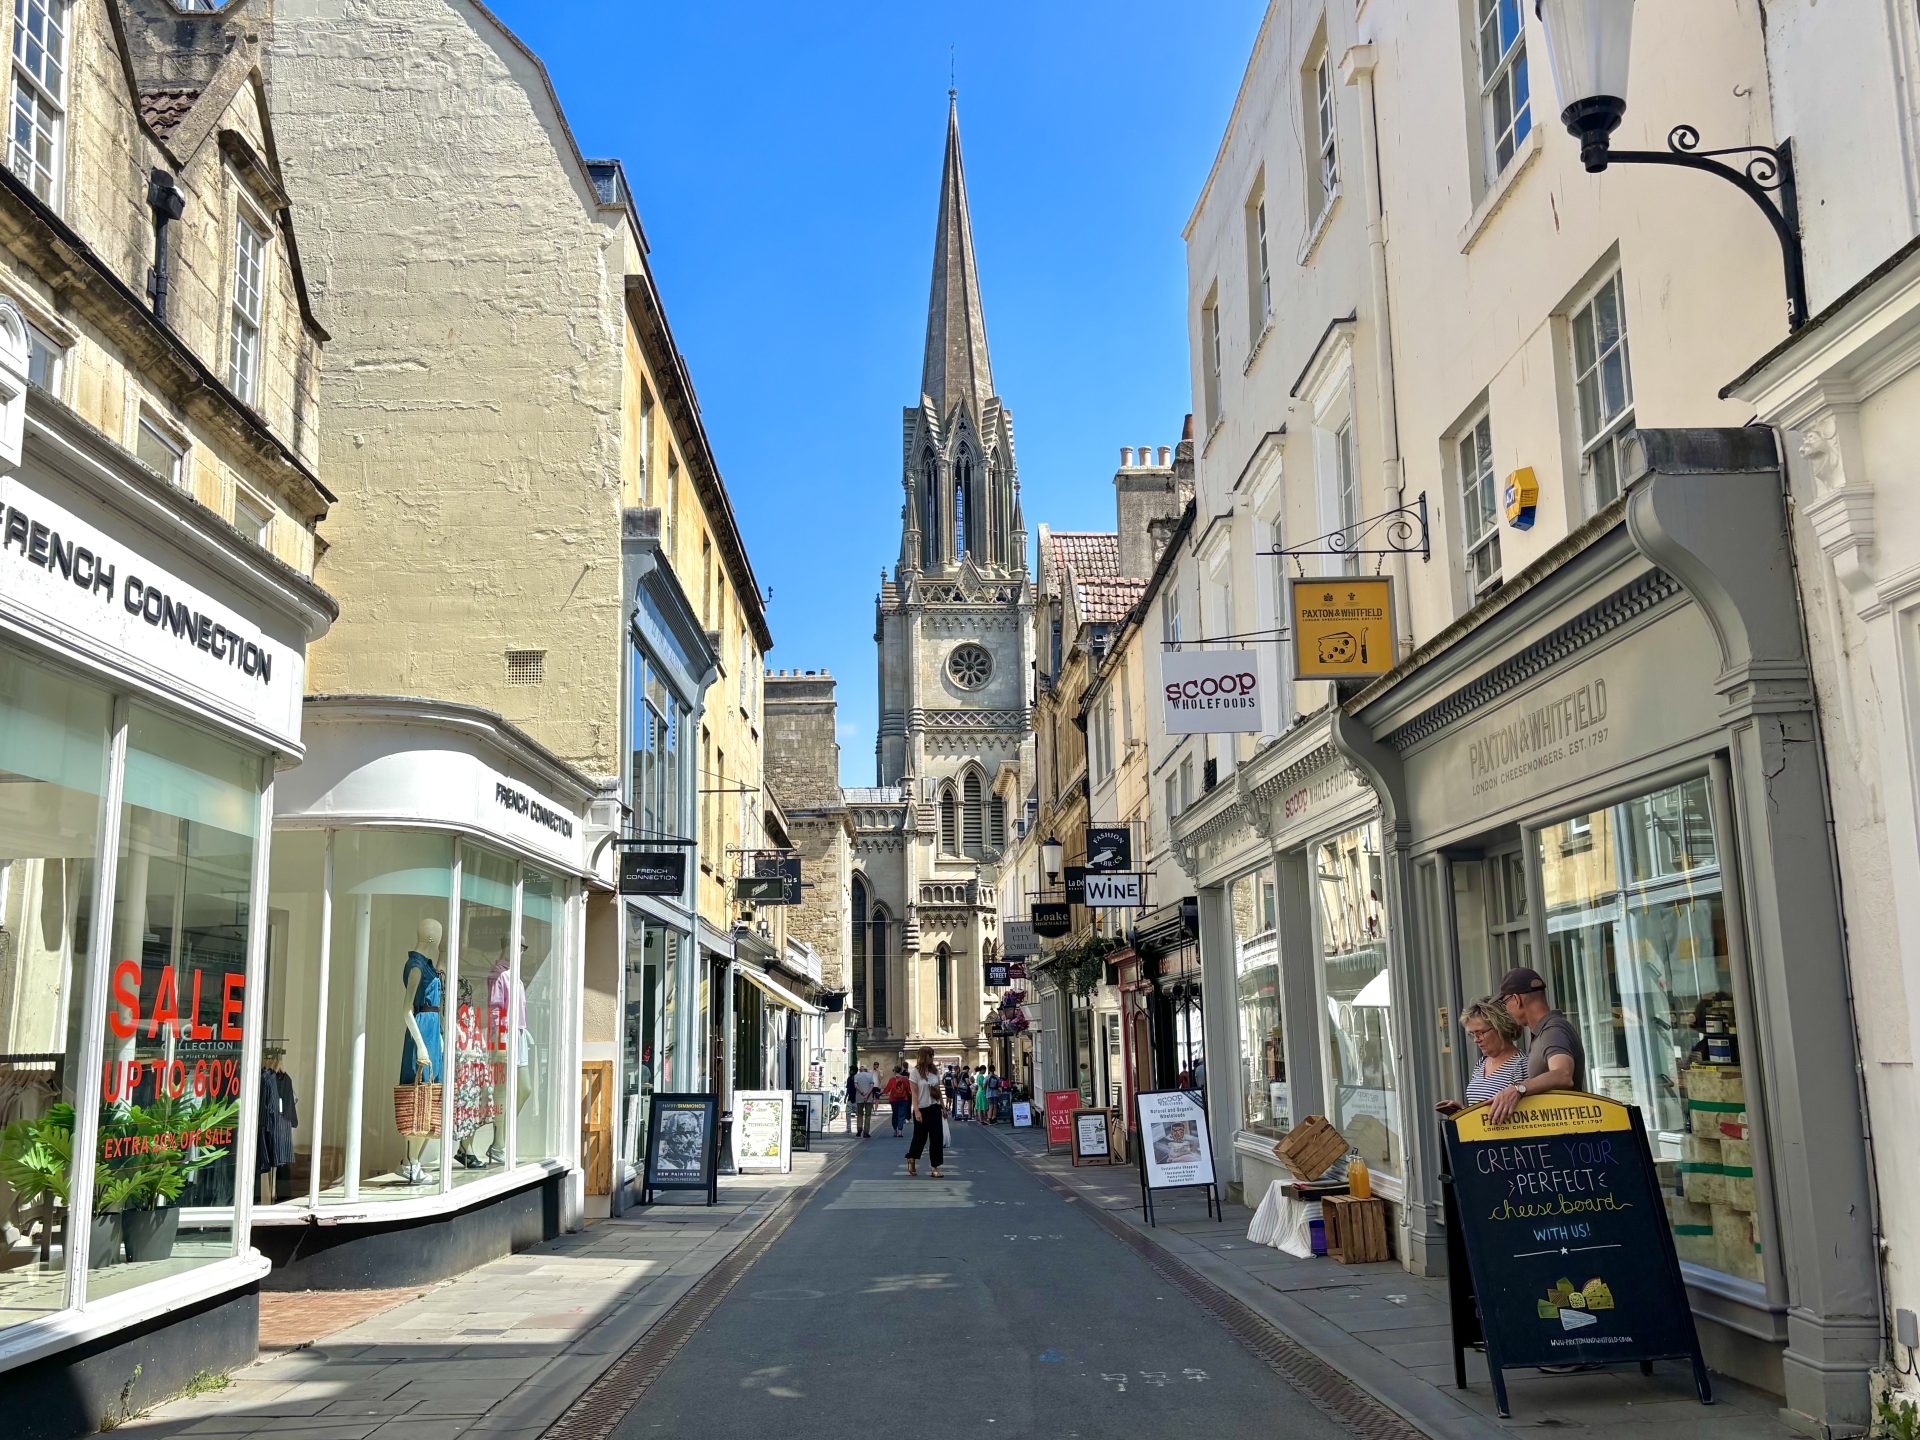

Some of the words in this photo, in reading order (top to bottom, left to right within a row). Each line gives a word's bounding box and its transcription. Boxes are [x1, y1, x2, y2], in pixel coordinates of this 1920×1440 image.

[0, 502, 115, 603] RENCH
[124, 575, 272, 685] CONNECTION
[1172, 698, 1256, 710] WHOLEFOODS
[1472, 778, 1498, 796] LONDON
[1500, 748, 1566, 784] CHEESEMONGERS.
[496, 782, 529, 816] FRENCH
[530, 800, 573, 839] CONNECTION
[1093, 832, 1124, 844] FASHION
[1035, 912, 1068, 922] Loake
[110, 960, 245, 1041] SALE
[458, 1003, 508, 1051] SALE
[104, 1060, 142, 1103] UP
[152, 1059, 186, 1100] TO
[194, 1059, 240, 1098] 60%
[104, 1136, 149, 1159] EXTRA
[180, 1128, 202, 1150] OFF
[205, 1127, 233, 1146] SALE
[1476, 1144, 1554, 1174] CREATE
[1563, 1140, 1619, 1167] YOUR
[1517, 1168, 1594, 1195] PERFECT
[1533, 1228, 1568, 1241] WITH
[1572, 1222, 1591, 1237] US!
